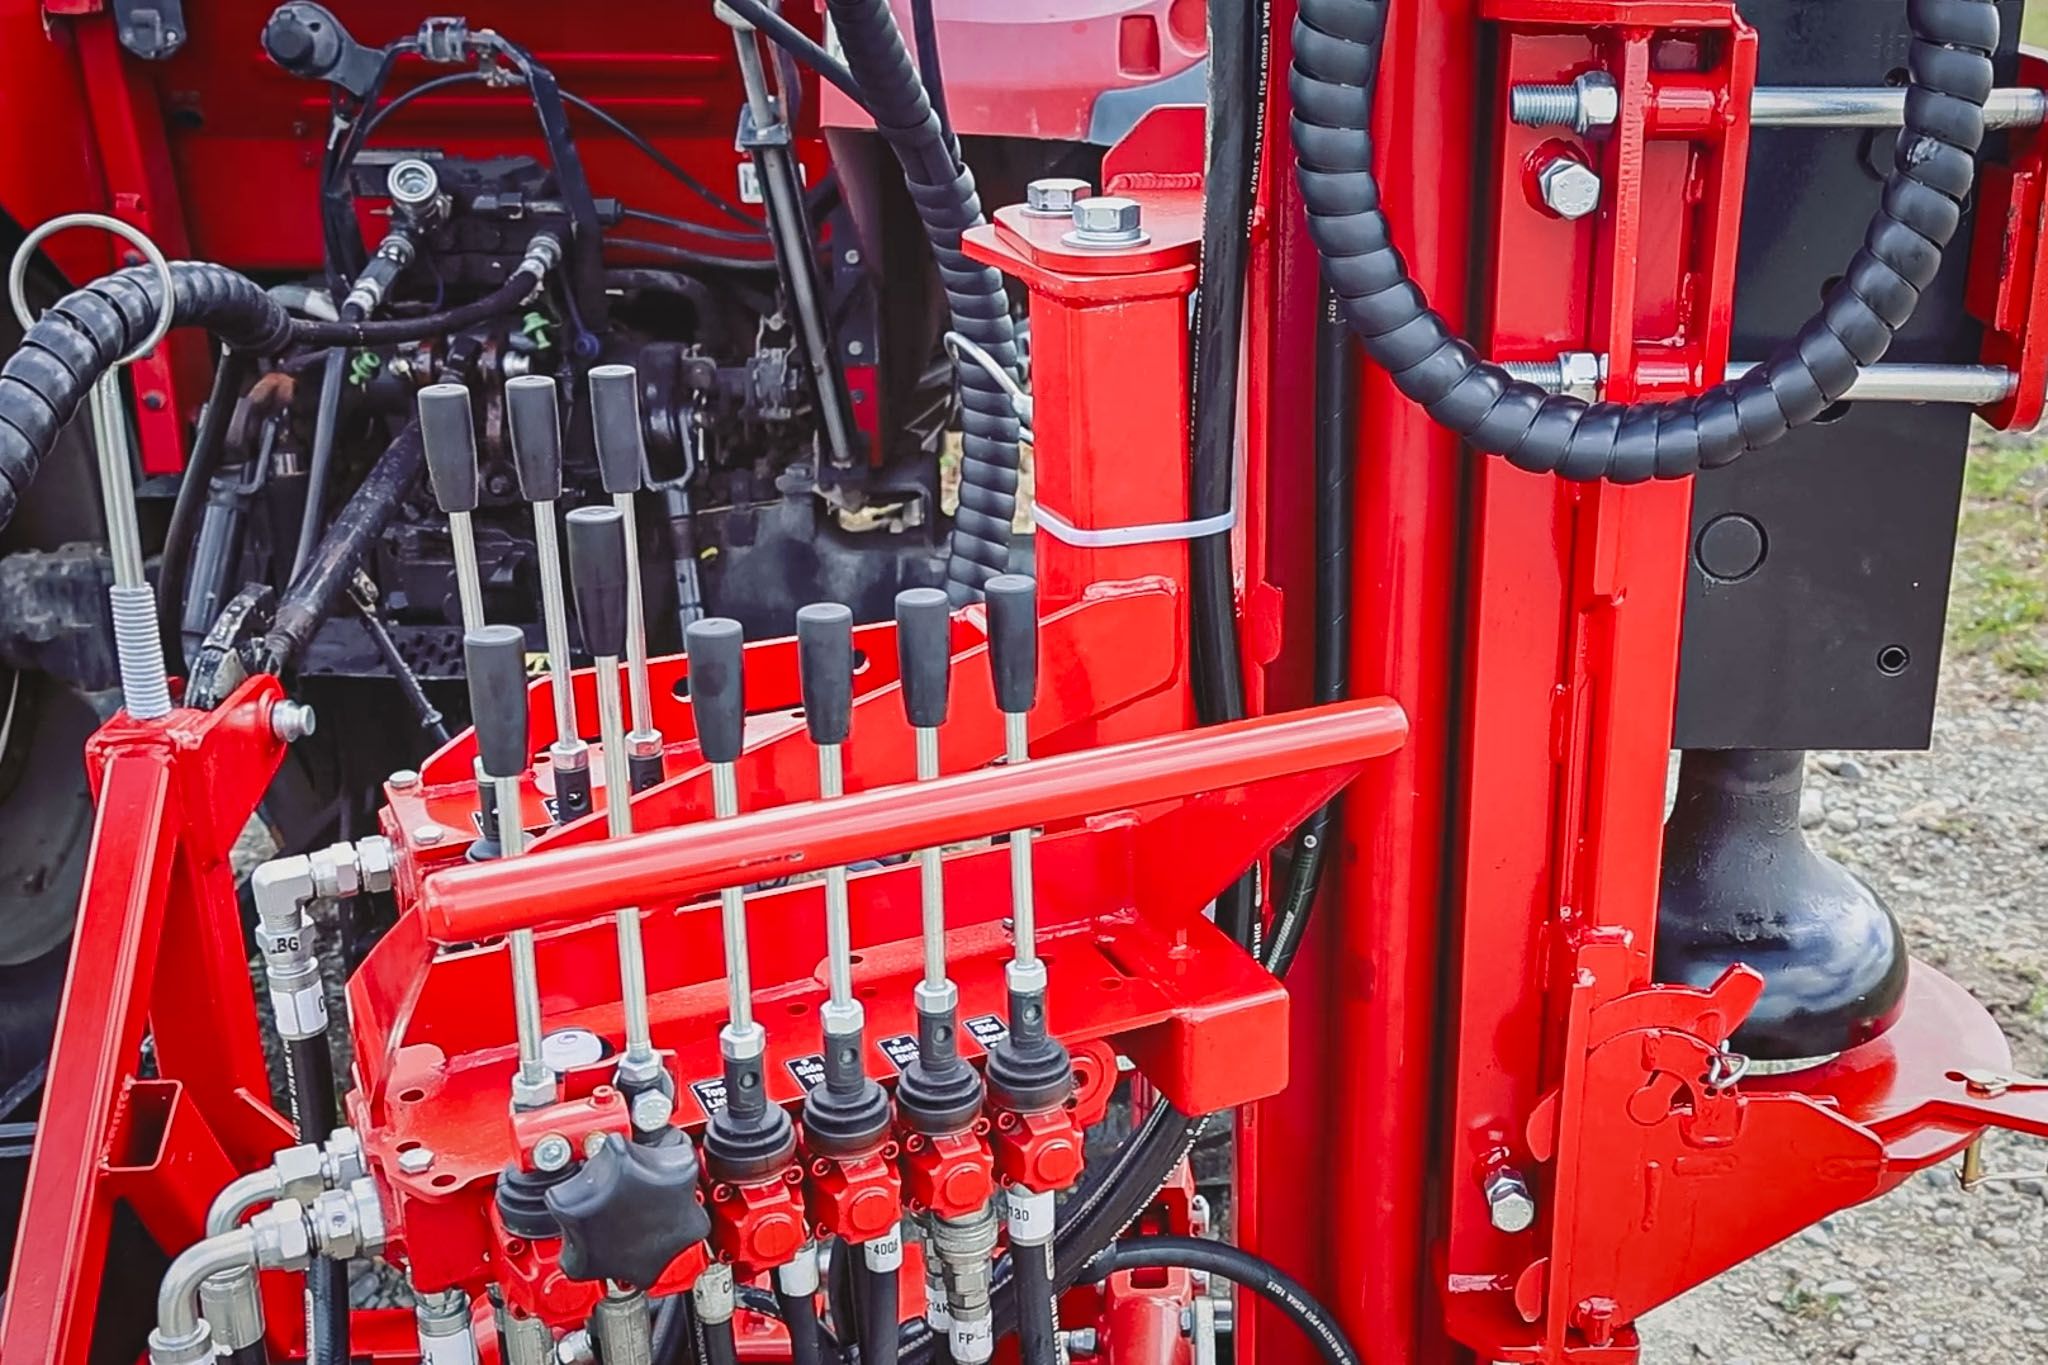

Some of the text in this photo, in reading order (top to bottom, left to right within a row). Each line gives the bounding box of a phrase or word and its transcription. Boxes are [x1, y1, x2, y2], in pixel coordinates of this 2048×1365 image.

[1262, 1, 1271, 29] BAR
[1260, 33, 1270, 70] (4000
[1257, 71, 1268, 96] PSI)
[1253, 922, 1262, 943] DIN
[271, 936, 300, 955] BG
[976, 1029, 1010, 1045] Moun
[886, 1042, 918, 1056] Mast
[795, 1062, 825, 1076] Side
[700, 1086, 728, 1099] Top
[705, 1094, 728, 1110] Lin
[1330, 1339, 1346, 1359] BAR
